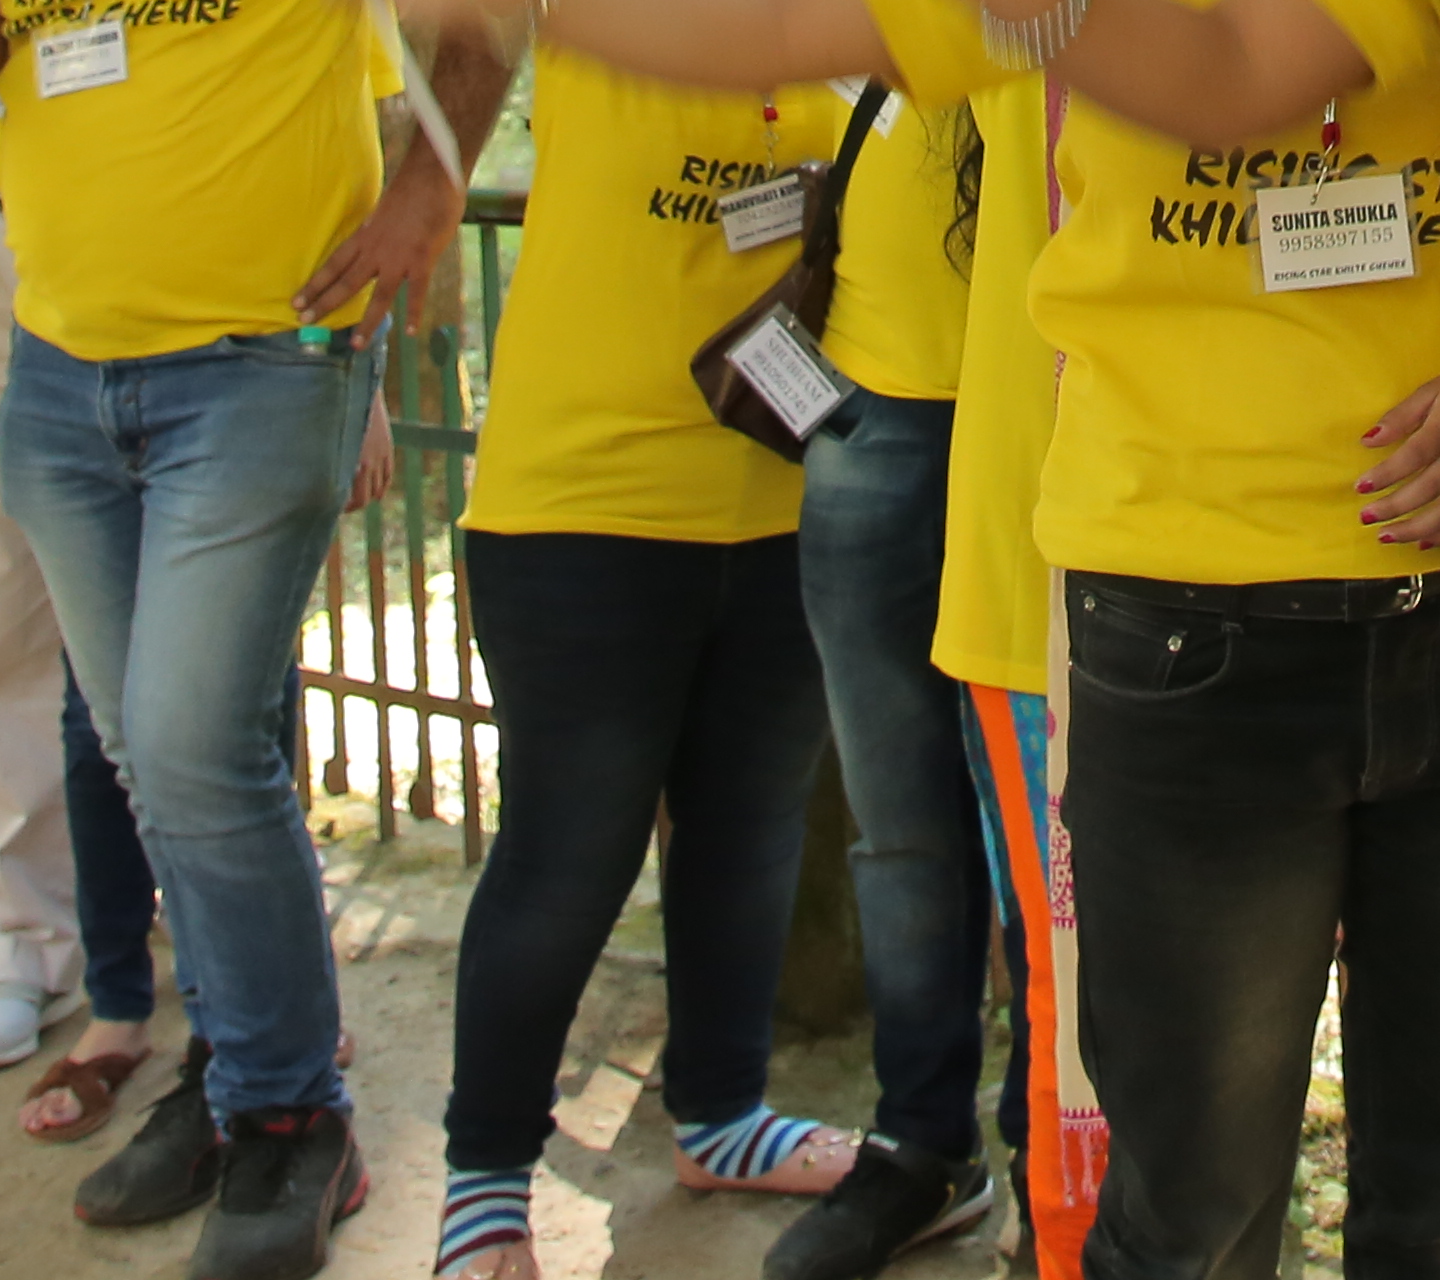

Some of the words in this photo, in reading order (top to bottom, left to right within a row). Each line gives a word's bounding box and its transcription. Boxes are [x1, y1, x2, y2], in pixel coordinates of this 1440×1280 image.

[681, 154, 780, 190] RISIN
[649, 187, 720, 225] KHIL
[1150, 195, 1258, 249] KHIL
[1271, 209, 1331, 232] SUNITA
[1333, 203, 1398, 226] SHUKLA
[1278, 226, 1394, 254] 9958397155
[1274, 270, 1308, 282] RISING
[1309, 268, 1333, 278] STAR
[1335, 263, 1366, 275] KHILTE
[1369, 258, 1407, 272] CHEHRE
